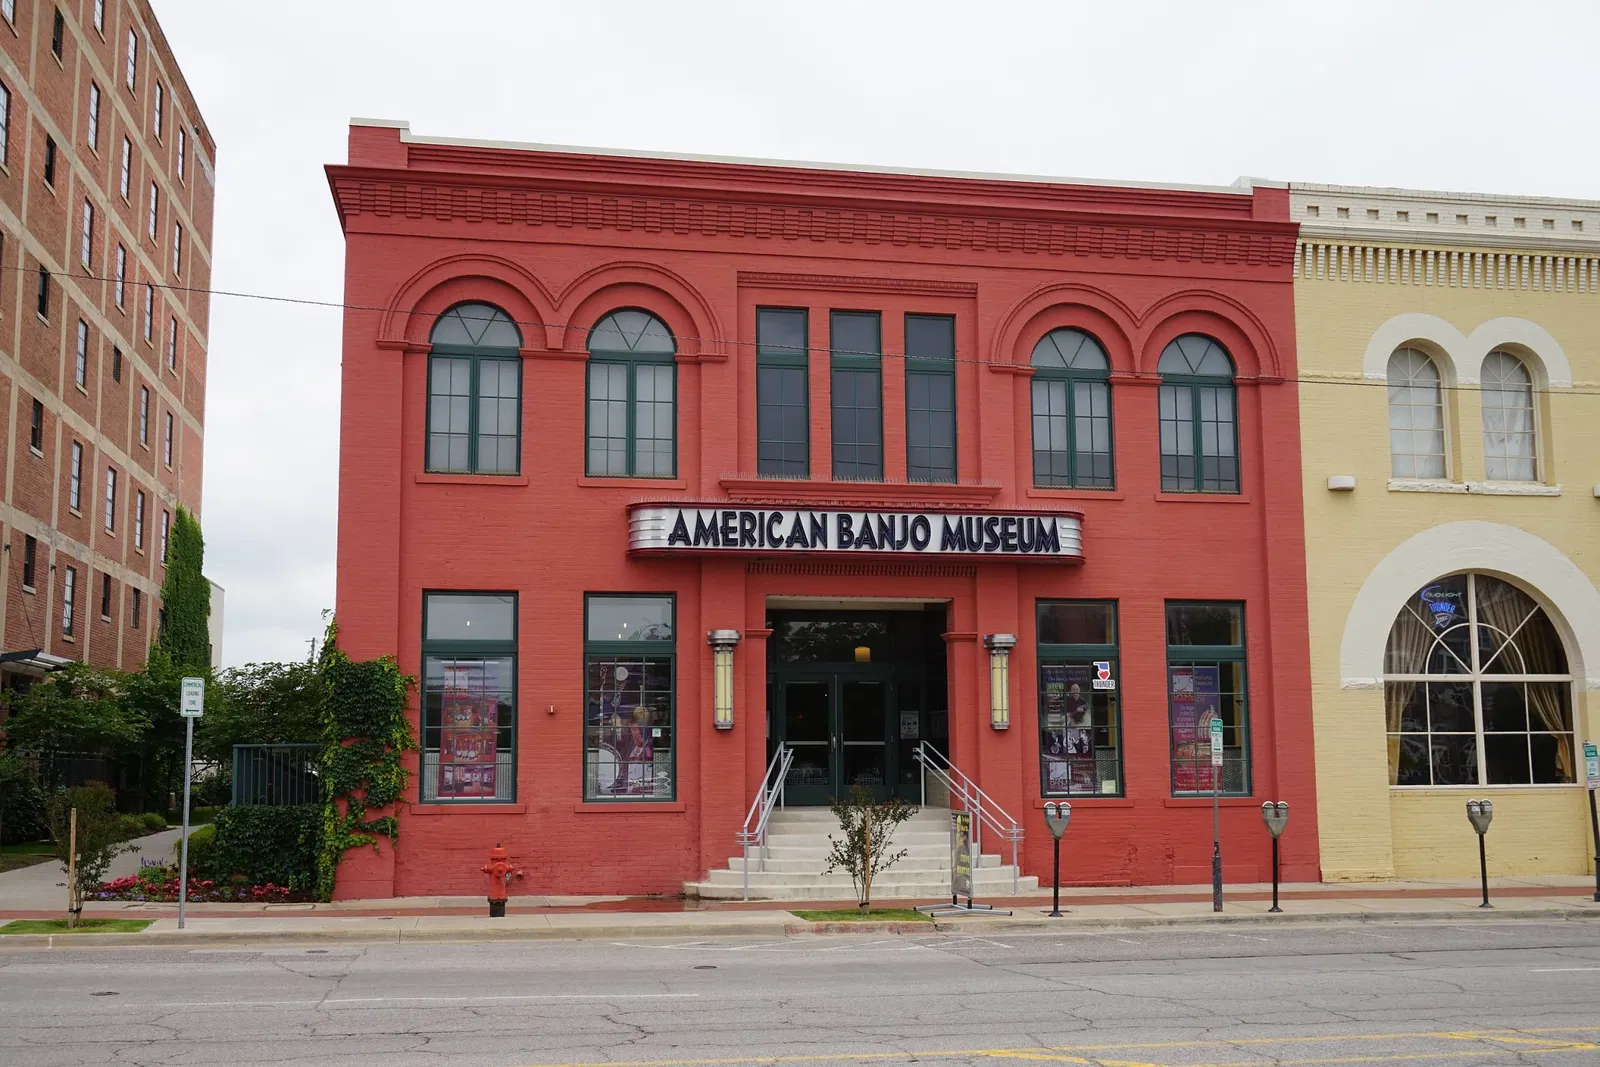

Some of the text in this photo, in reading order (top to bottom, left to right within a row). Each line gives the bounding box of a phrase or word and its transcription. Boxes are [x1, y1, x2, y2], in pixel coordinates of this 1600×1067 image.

[668, 508, 1061, 553] AMERICAN BANJO MUSEUM
[1429, 602, 1456, 614] THUNDER
